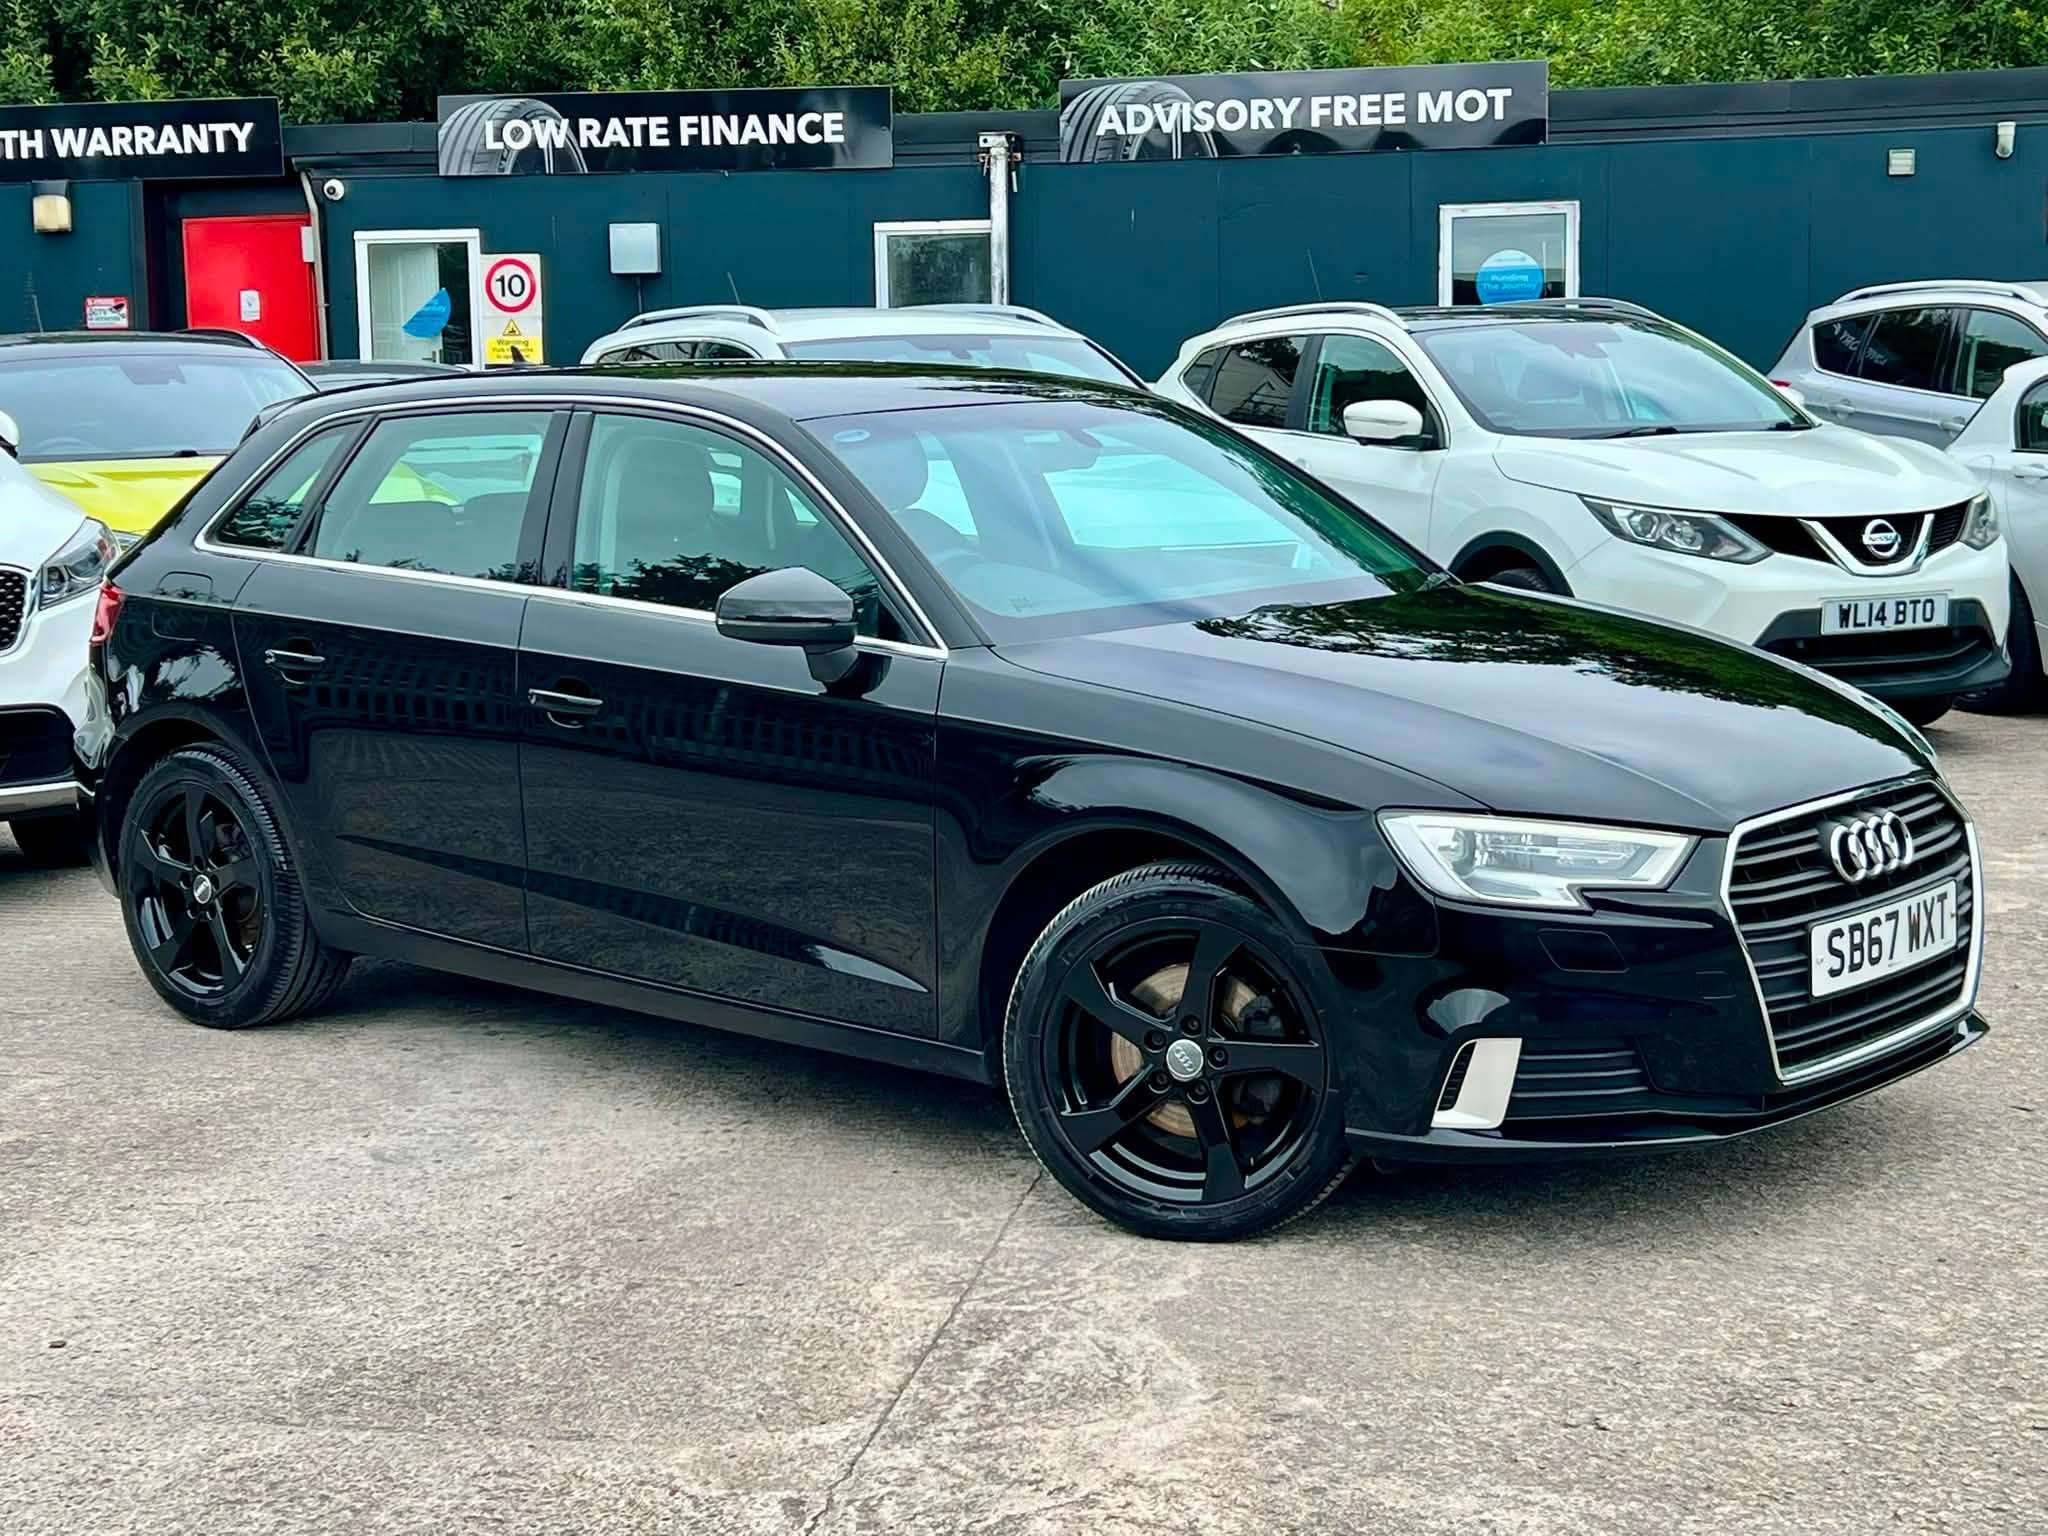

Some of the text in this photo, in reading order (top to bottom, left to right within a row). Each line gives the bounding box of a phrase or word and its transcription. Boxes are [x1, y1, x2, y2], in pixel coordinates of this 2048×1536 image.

[485, 112, 845, 150] LOW RATE FINANCE
[1096, 88, 1513, 137] ADVISORY FREE MOT
[51, 122, 254, 158] WARRANTY
[495, 274, 526, 298] 10
[1839, 598, 1935, 629] WL14 BTO
[1827, 890, 1948, 979] SB67 WXT
